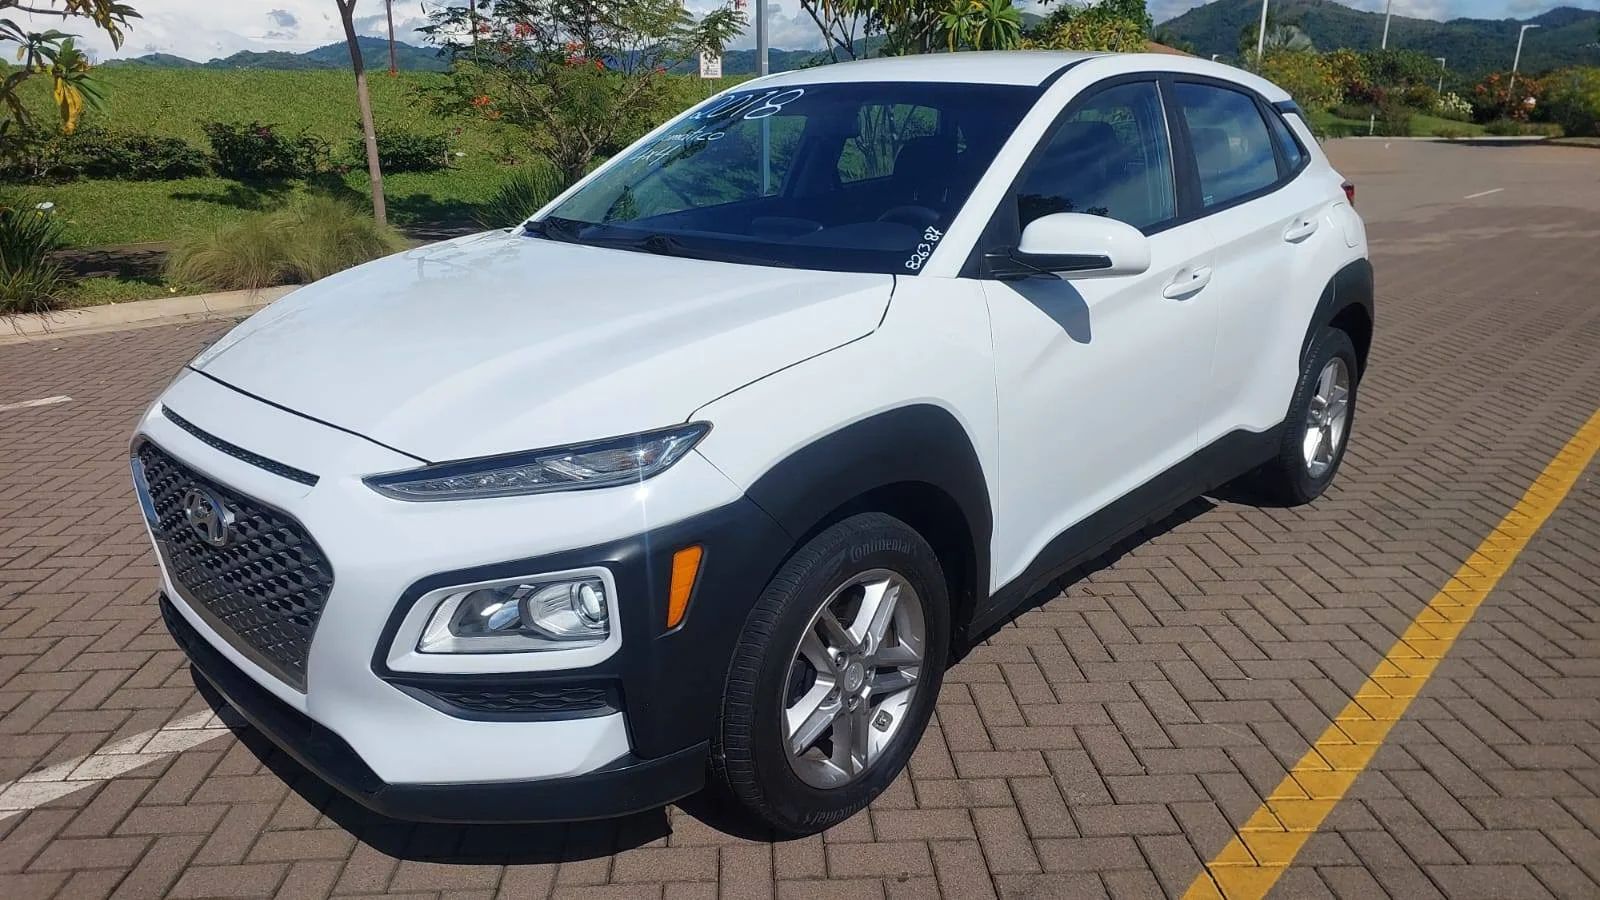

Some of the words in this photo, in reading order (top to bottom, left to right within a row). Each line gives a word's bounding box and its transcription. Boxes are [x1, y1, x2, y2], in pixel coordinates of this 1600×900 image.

[688, 88, 805, 121] 2018
[904, 225, 944, 270] 8263.87
[850, 537, 911, 562] Continental
